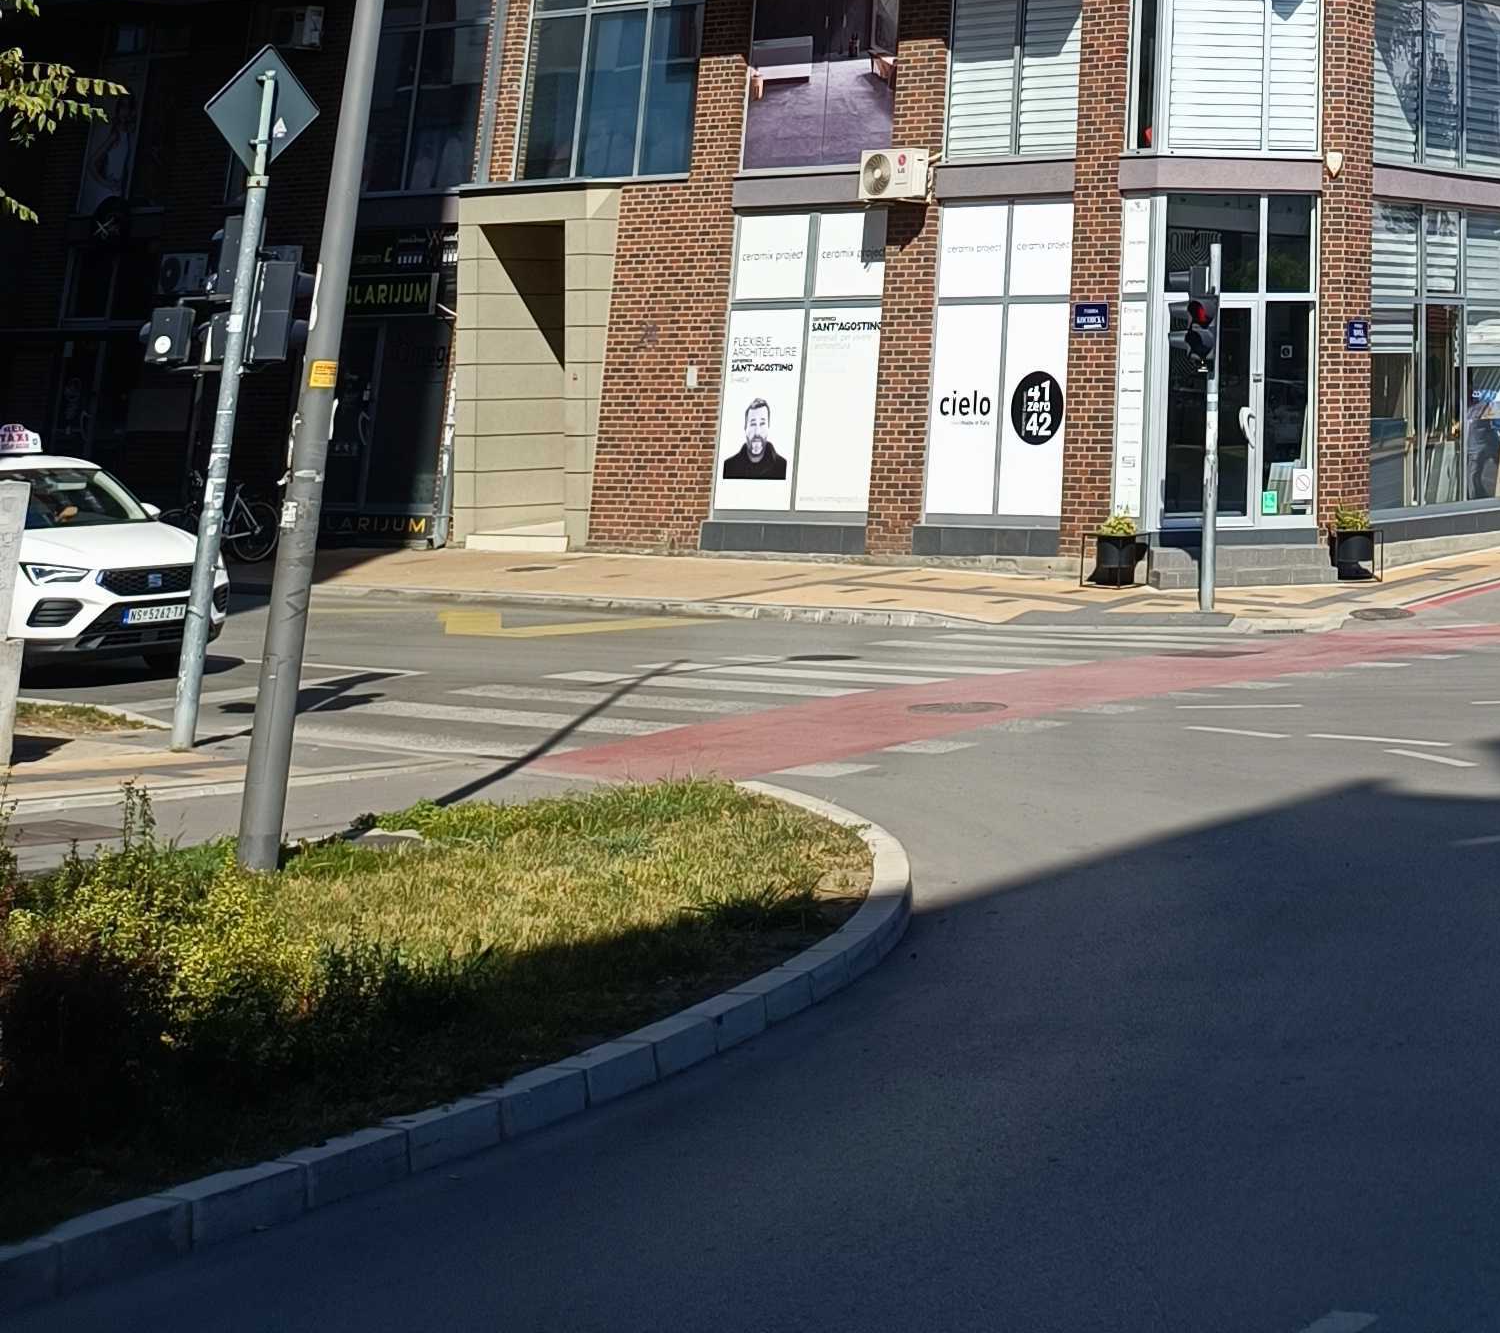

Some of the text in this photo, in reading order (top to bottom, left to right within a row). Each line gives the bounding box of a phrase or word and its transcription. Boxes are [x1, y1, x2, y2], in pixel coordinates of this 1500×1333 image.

[821, 246, 885, 261] ceramix projec
[1047, 240, 1070, 252] projec
[742, 248, 804, 263] ceramix project
[346, 282, 429, 305] LARIJUM
[733, 336, 772, 347] FLEXIBLE
[732, 346, 797, 357] ARCHITECTURE
[1027, 380, 1051, 402] 41
[940, 389, 991, 416] cielo
[1026, 401, 1051, 412] zero
[1026, 412, 1052, 436] 42
[0, 433, 29, 442] TAXI
